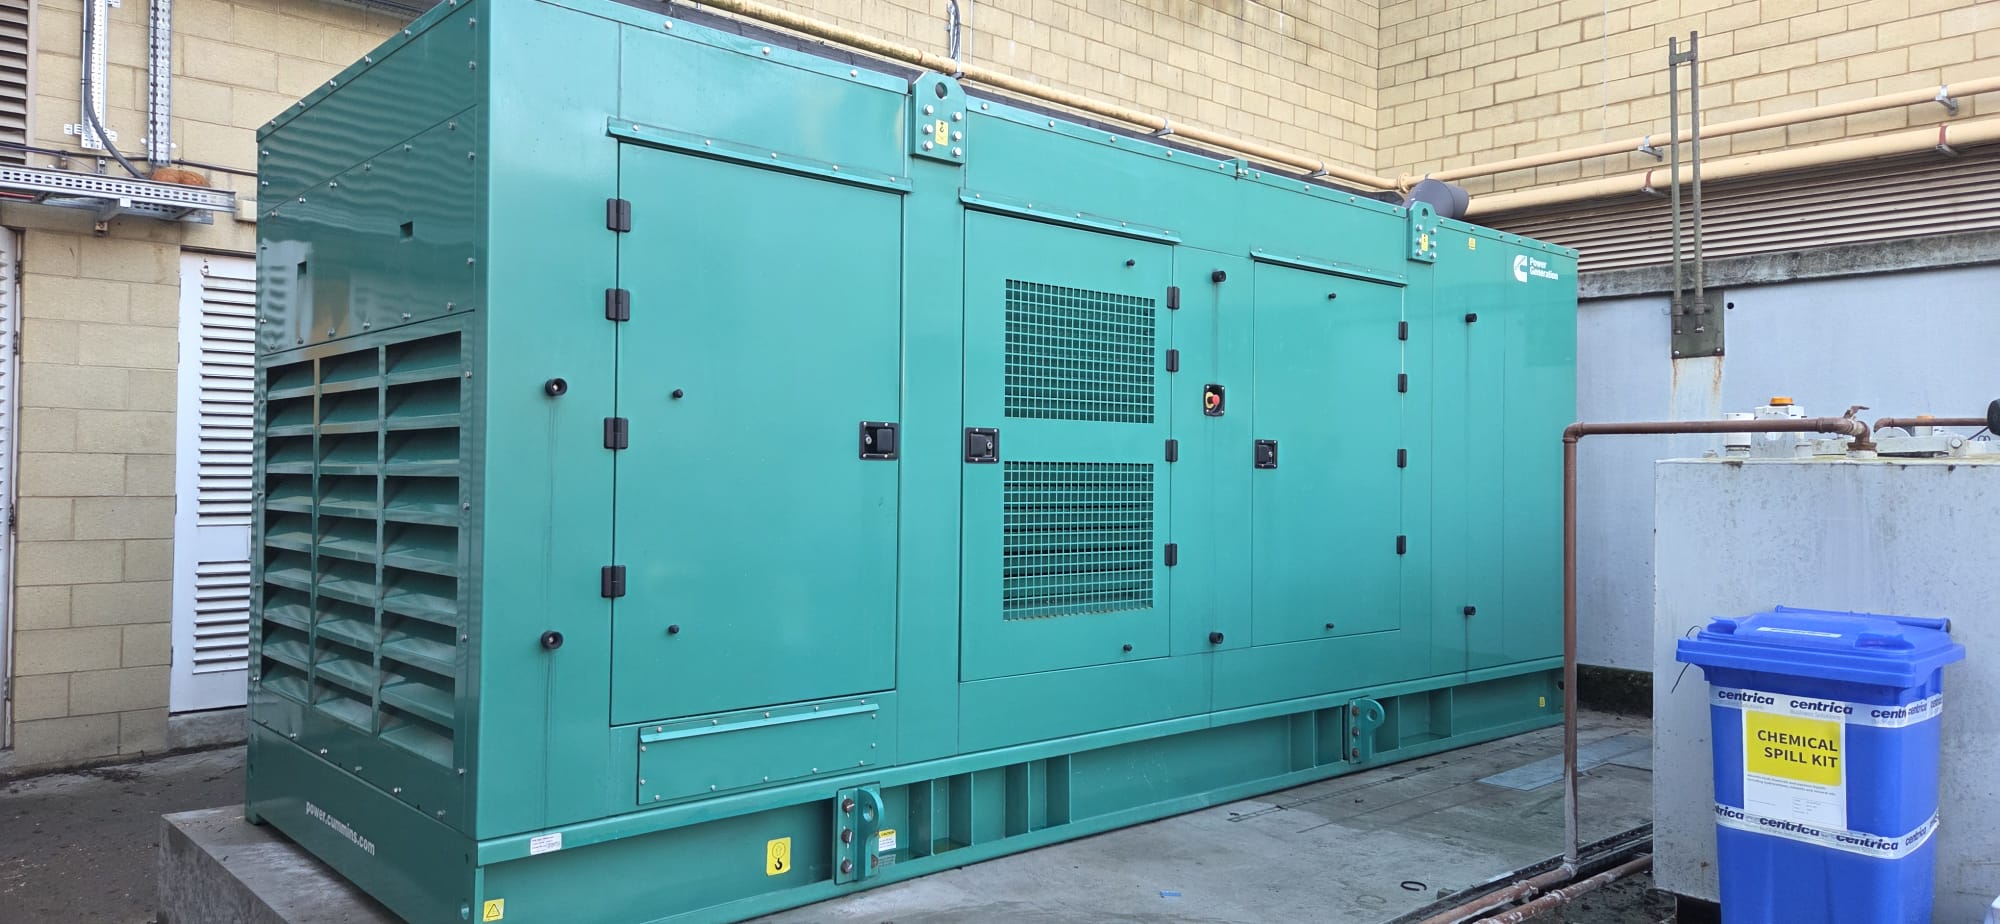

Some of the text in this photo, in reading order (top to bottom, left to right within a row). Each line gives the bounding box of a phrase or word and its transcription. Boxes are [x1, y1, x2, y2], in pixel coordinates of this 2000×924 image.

[1530, 257, 1547, 268] Power
[1530, 266, 1558, 280] Generation
[1718, 690, 1775, 705] centrica
[1790, 700, 1853, 715] centrica
[1757, 729, 1838, 752] CHEMICAL
[1764, 746, 1838, 768] SPILL KIT
[305, 801, 376, 856] power.cummins.com
[1713, 805, 1744, 820] trica
[1759, 817, 1820, 837] centrica
[1836, 834, 1899, 850] centrica
